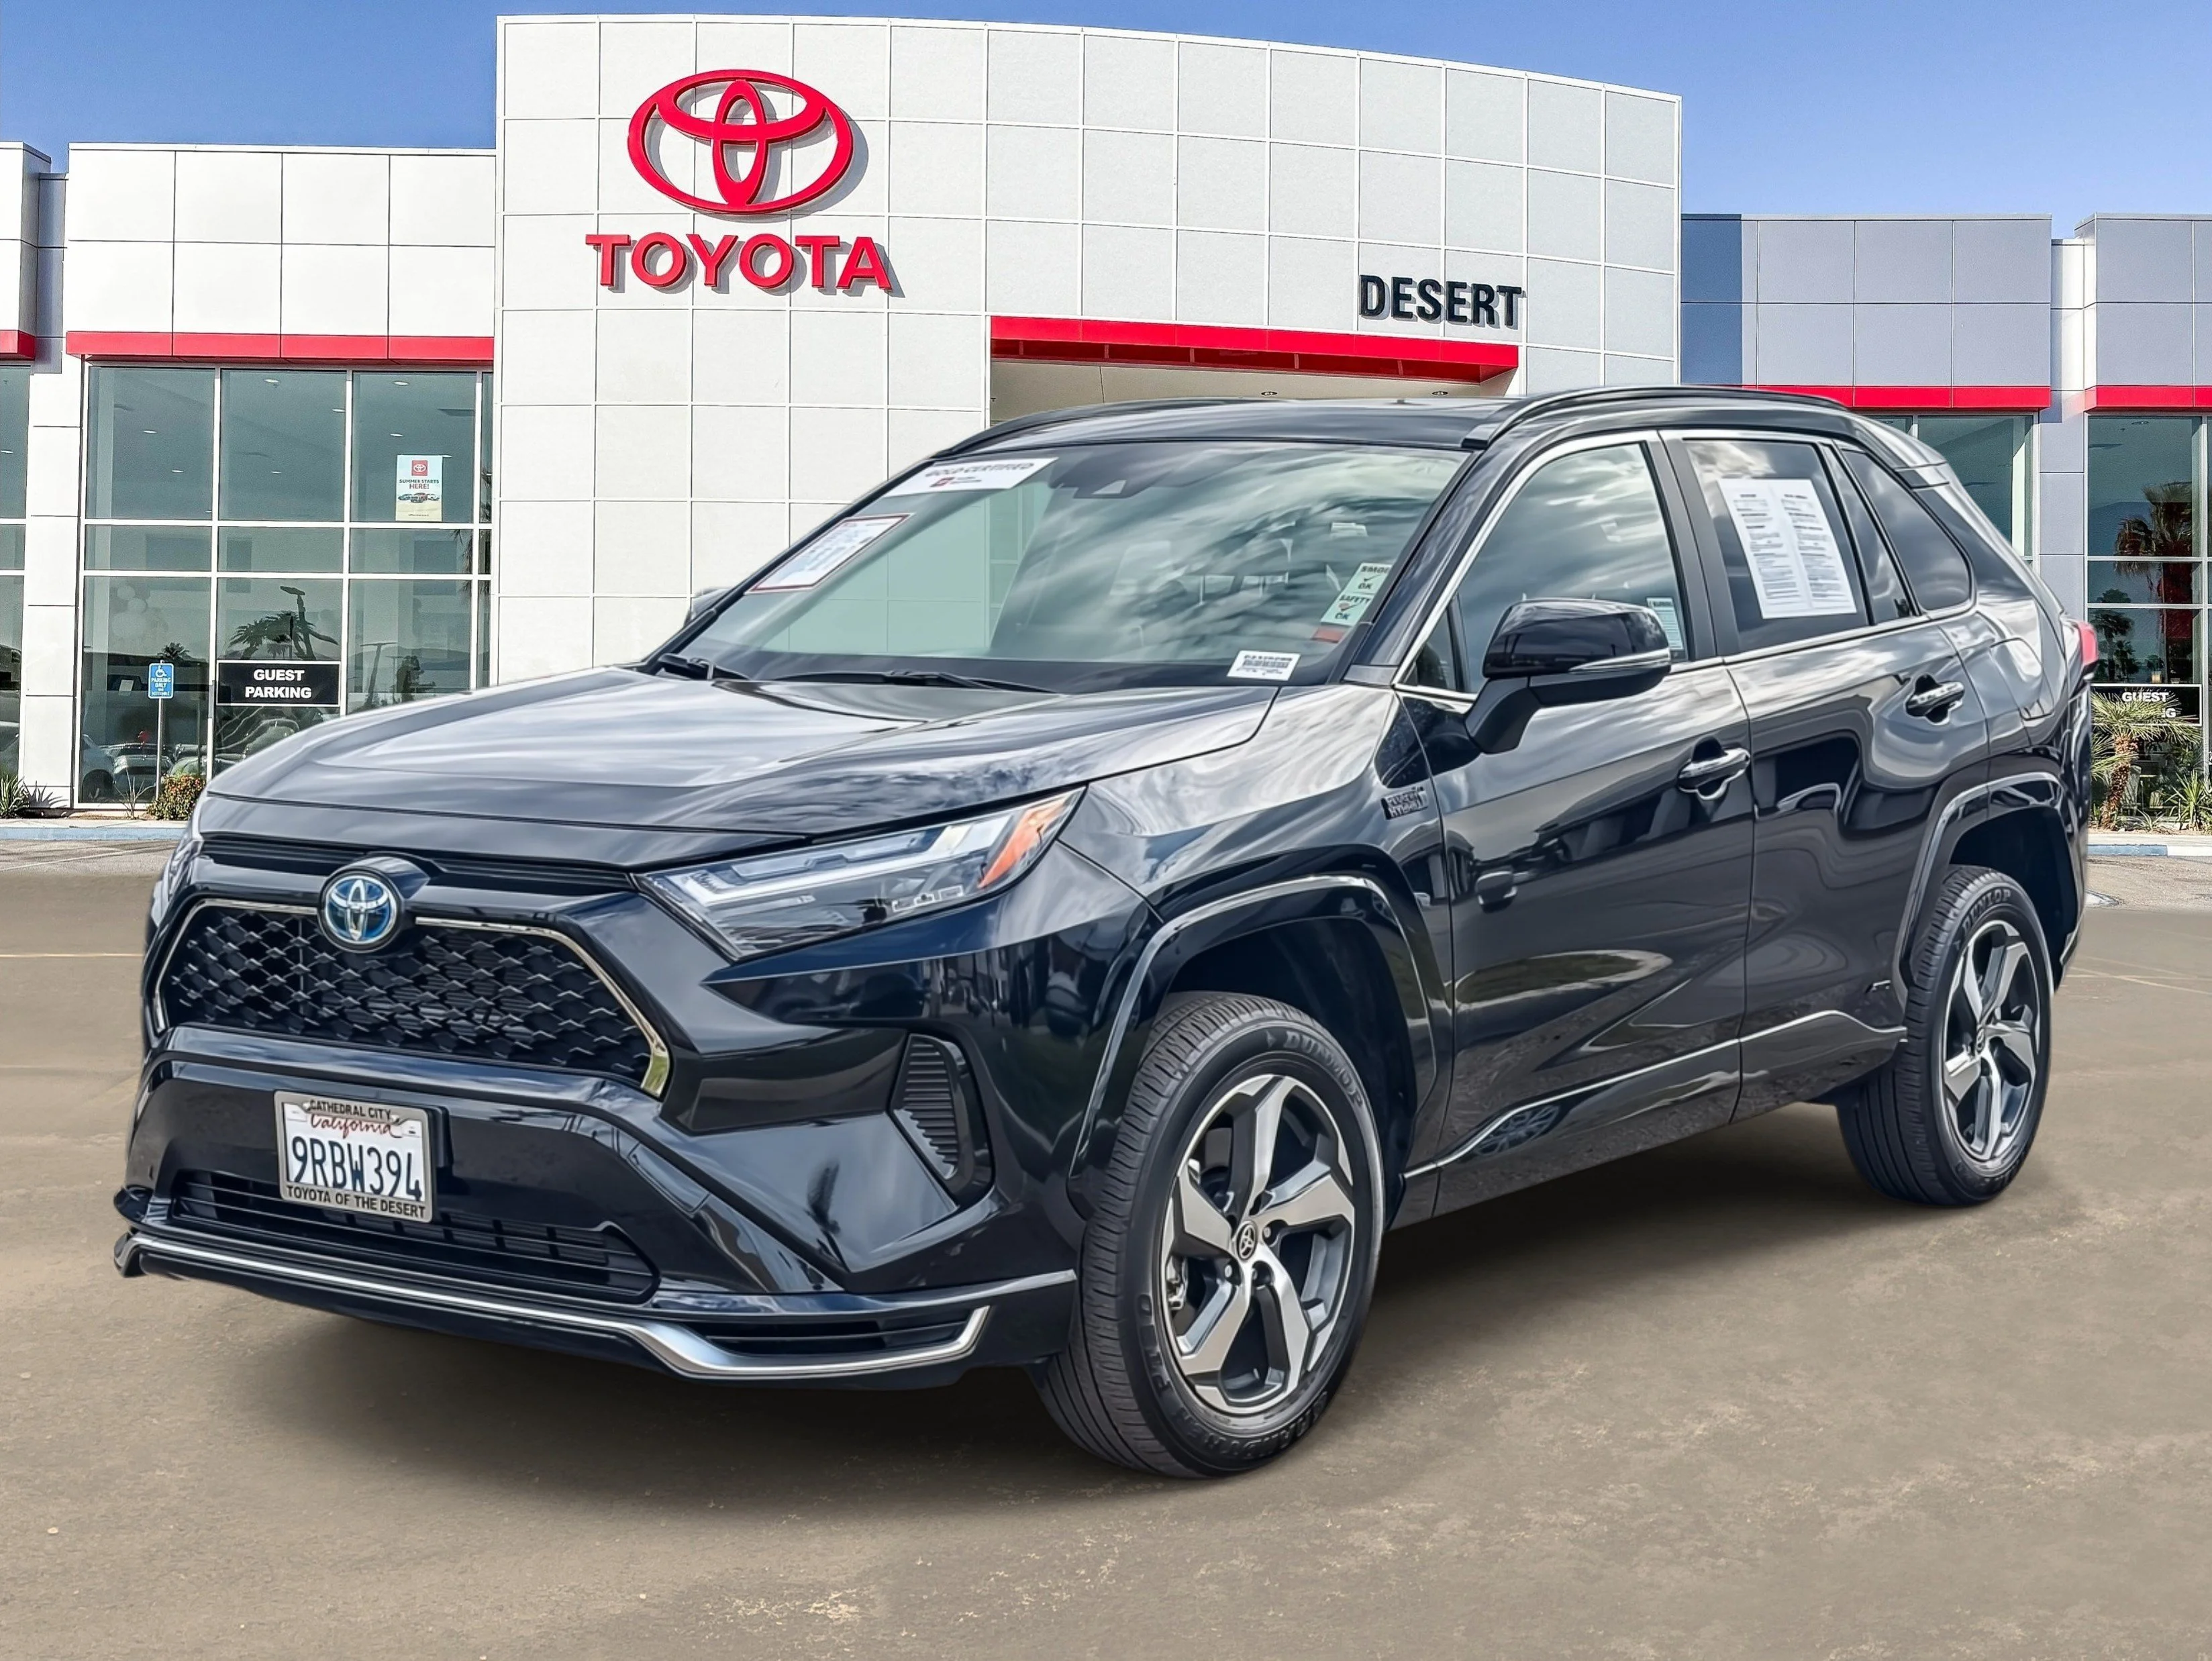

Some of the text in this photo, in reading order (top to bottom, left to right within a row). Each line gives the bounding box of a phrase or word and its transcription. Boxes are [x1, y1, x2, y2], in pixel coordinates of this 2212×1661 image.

[585, 232, 892, 291] TOYOTA
[1359, 274, 1522, 327] DESERT
[1340, 595, 1370, 604] SAFETY
[253, 669, 305, 681] GUEST
[245, 686, 312, 699] PARKING
[2122, 691, 2169, 703] GUEST
[309, 1100, 392, 1121] CATHEDRAL CITY
[292, 1136, 423, 1202] 9RBW394
[287, 1185, 425, 1219] TOYOTA OF THE DESERT
